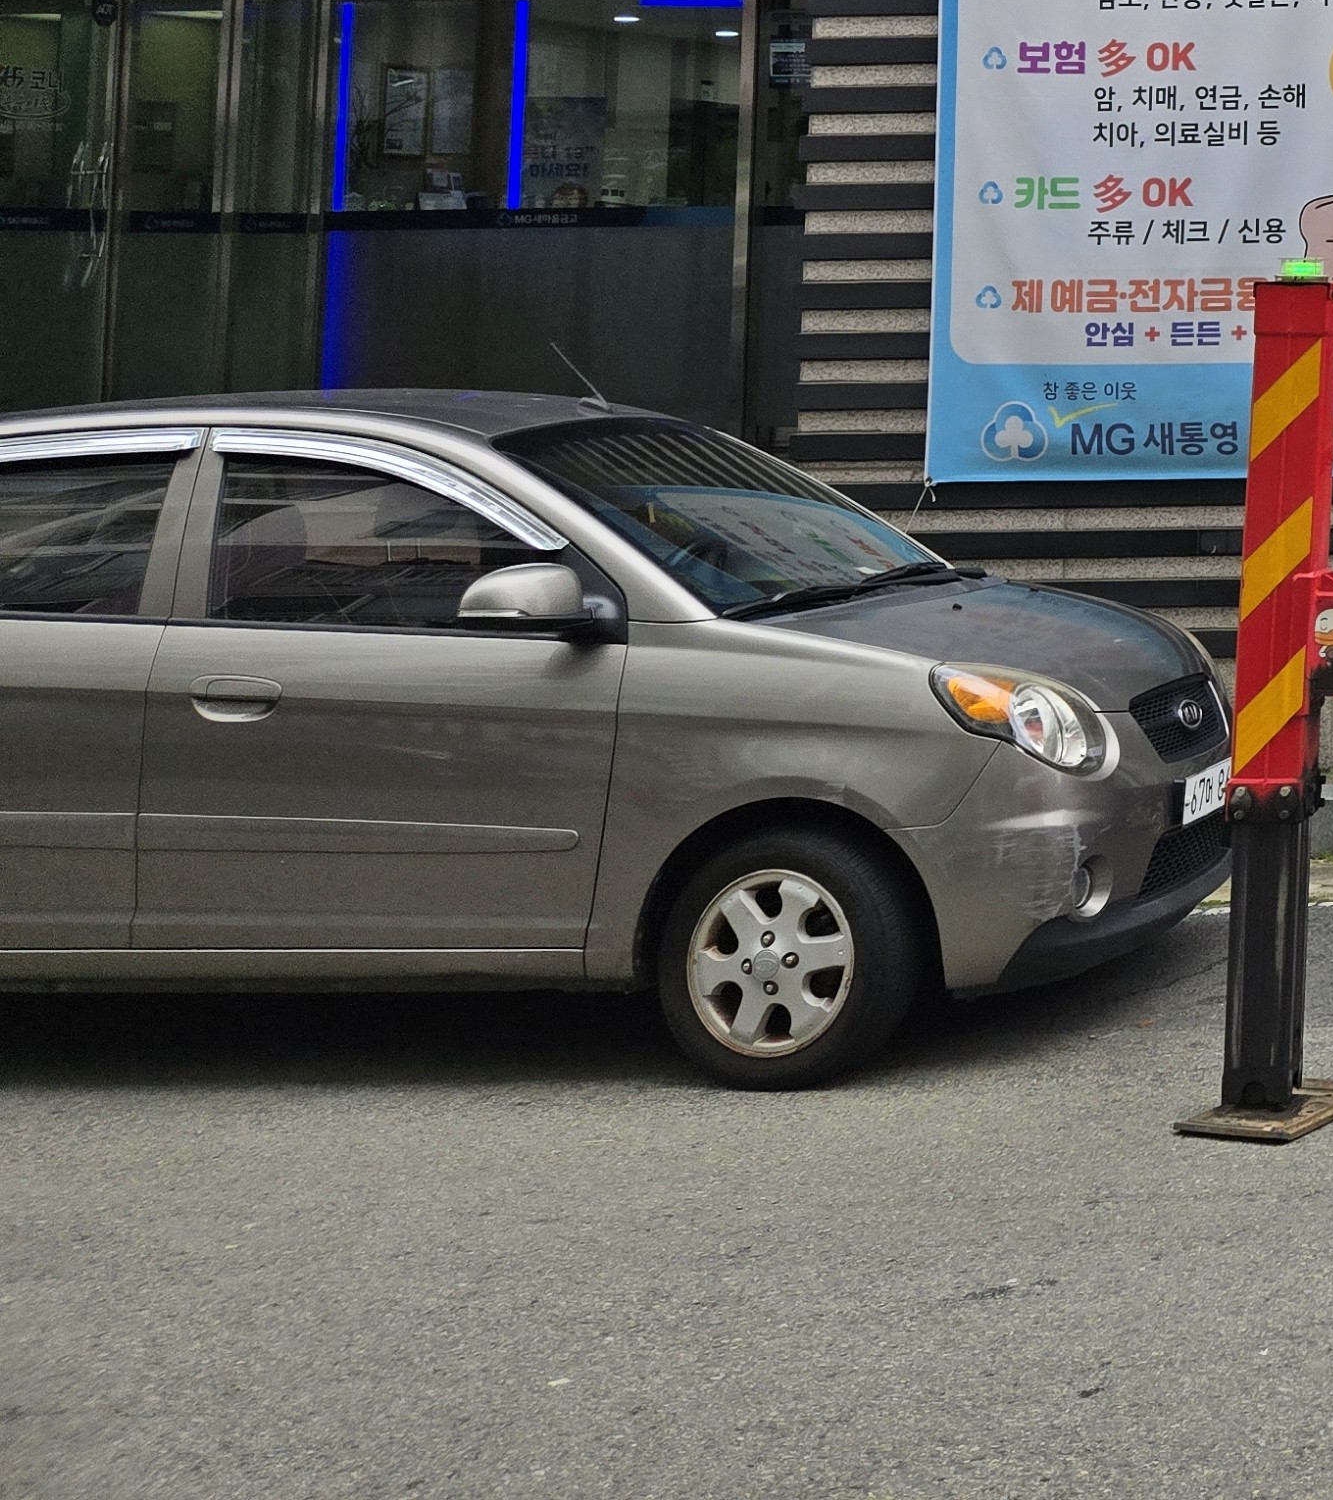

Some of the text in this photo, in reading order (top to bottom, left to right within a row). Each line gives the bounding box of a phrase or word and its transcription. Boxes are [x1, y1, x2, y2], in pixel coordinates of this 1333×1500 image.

[1016, 39, 1087, 75] 보험
[1146, 41, 1197, 73] OK
[1093, 82, 1307, 114] 암, 치매, 연금, 손해
[1092, 119, 1282, 149] 치아, 의료실비 등
[1014, 175, 1081, 211] 카드
[1142, 176, 1193, 208] OK
[1087, 218, 1135, 246] 주류
[1161, 217, 1211, 244] 체크
[1237, 216, 1288, 244] 신용
[1084, 320, 1135, 348] 안심
[1169, 319, 1222, 347] 든든
[1042, 379, 1138, 402] 참 좋은 이웃
